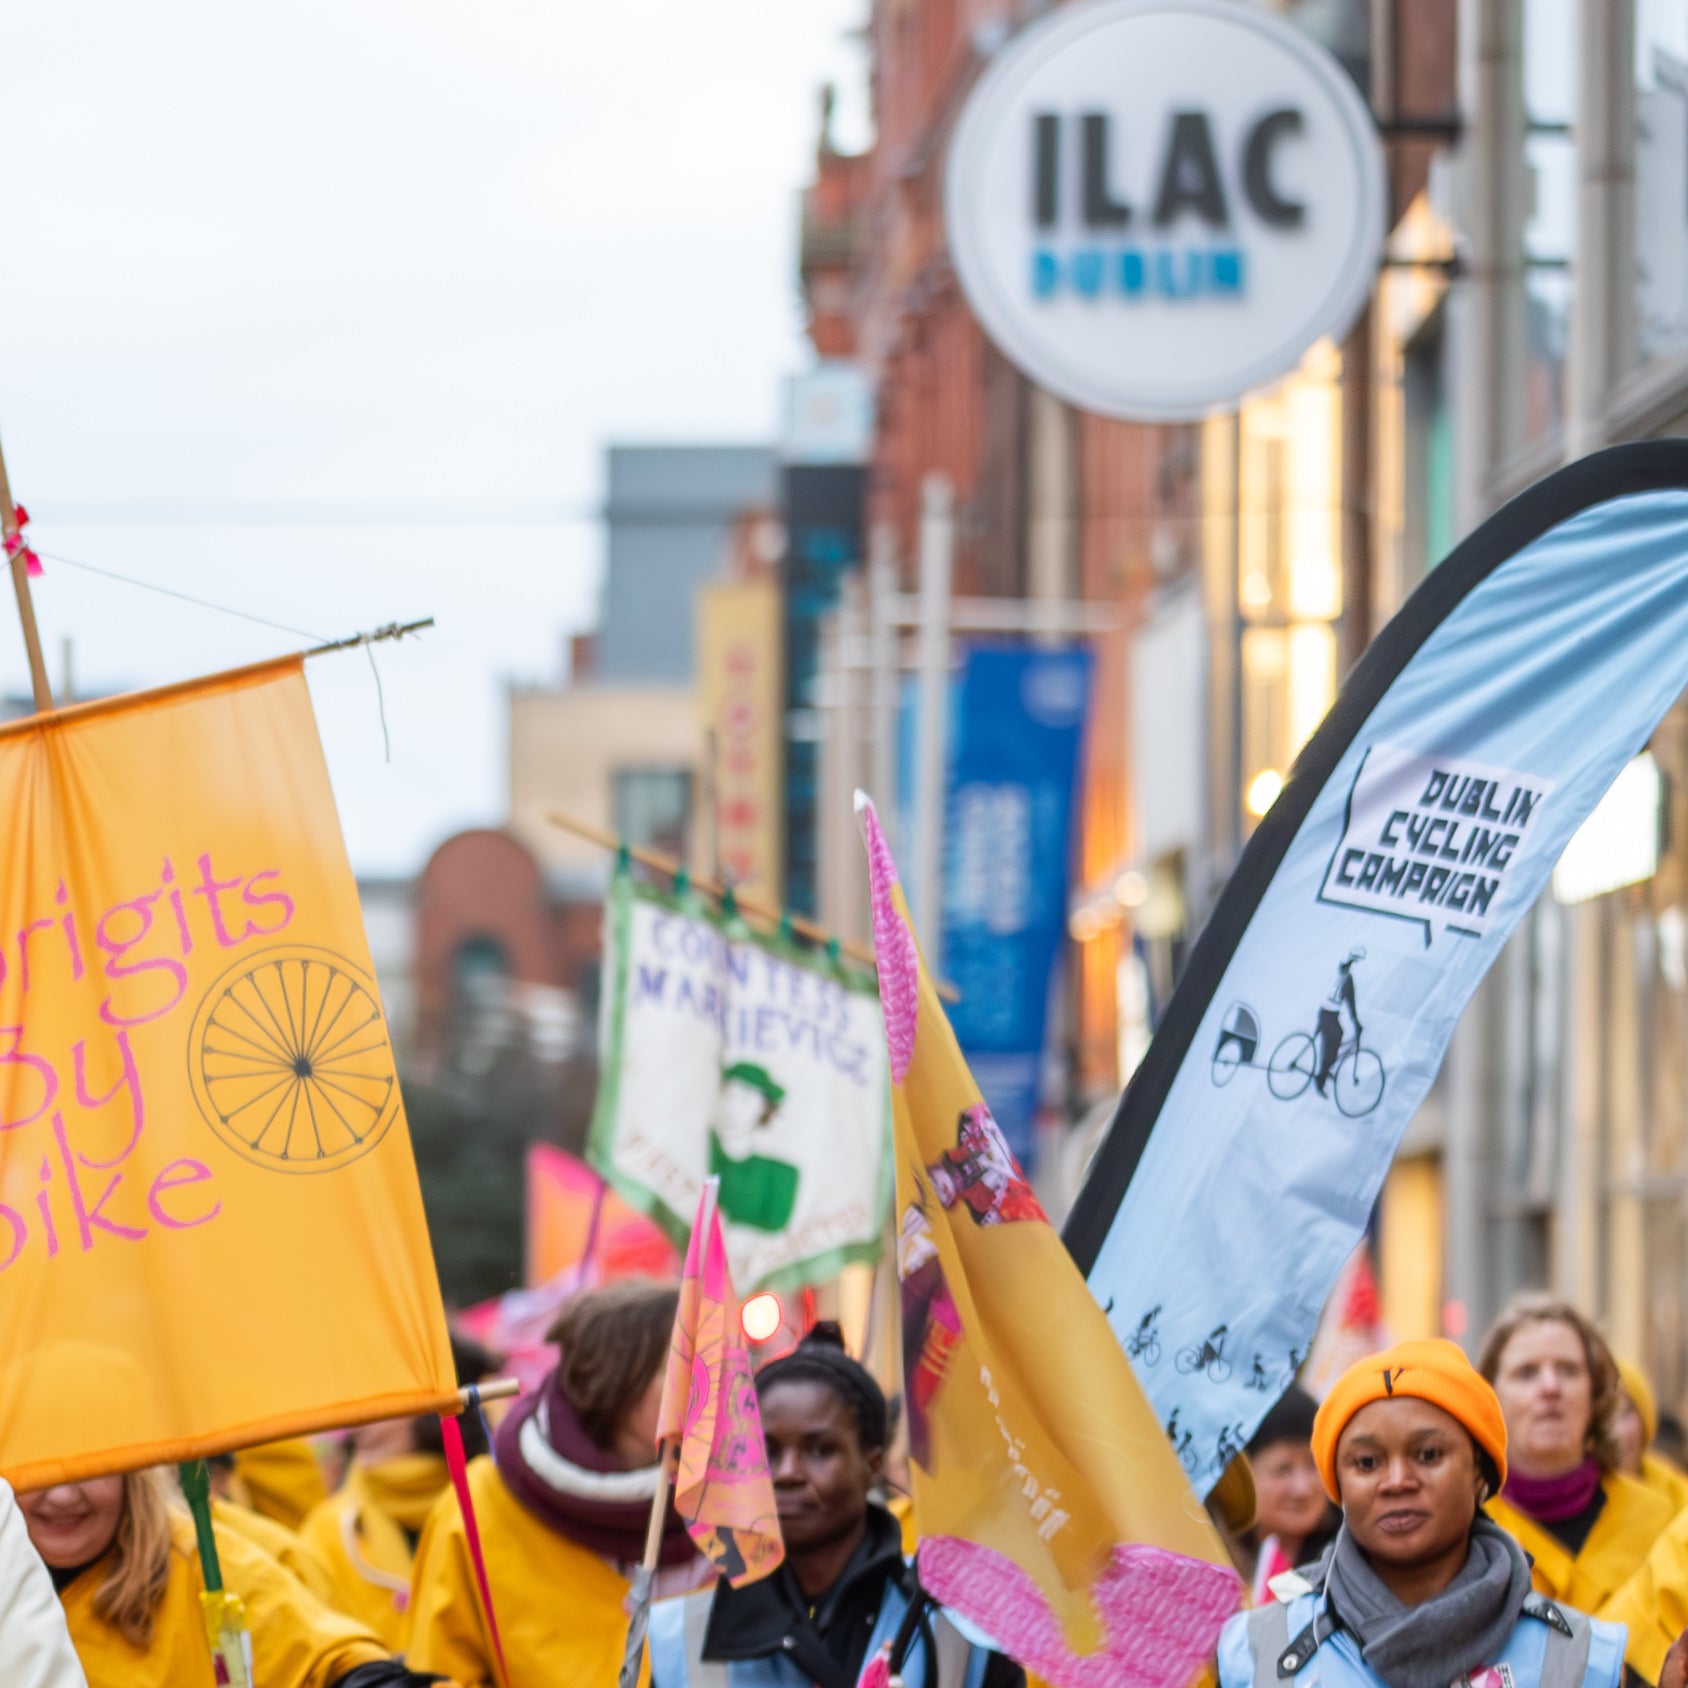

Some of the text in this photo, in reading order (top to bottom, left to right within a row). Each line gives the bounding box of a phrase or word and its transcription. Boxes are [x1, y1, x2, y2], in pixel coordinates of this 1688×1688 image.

[1034, 108, 1306, 232] ILAC
[1030, 249, 1246, 299] DUBLIN
[1417, 769, 1543, 829] DUBLIN
[1378, 810, 1521, 873] CYCLING
[1334, 848, 1501, 918] CAMPAIGN
